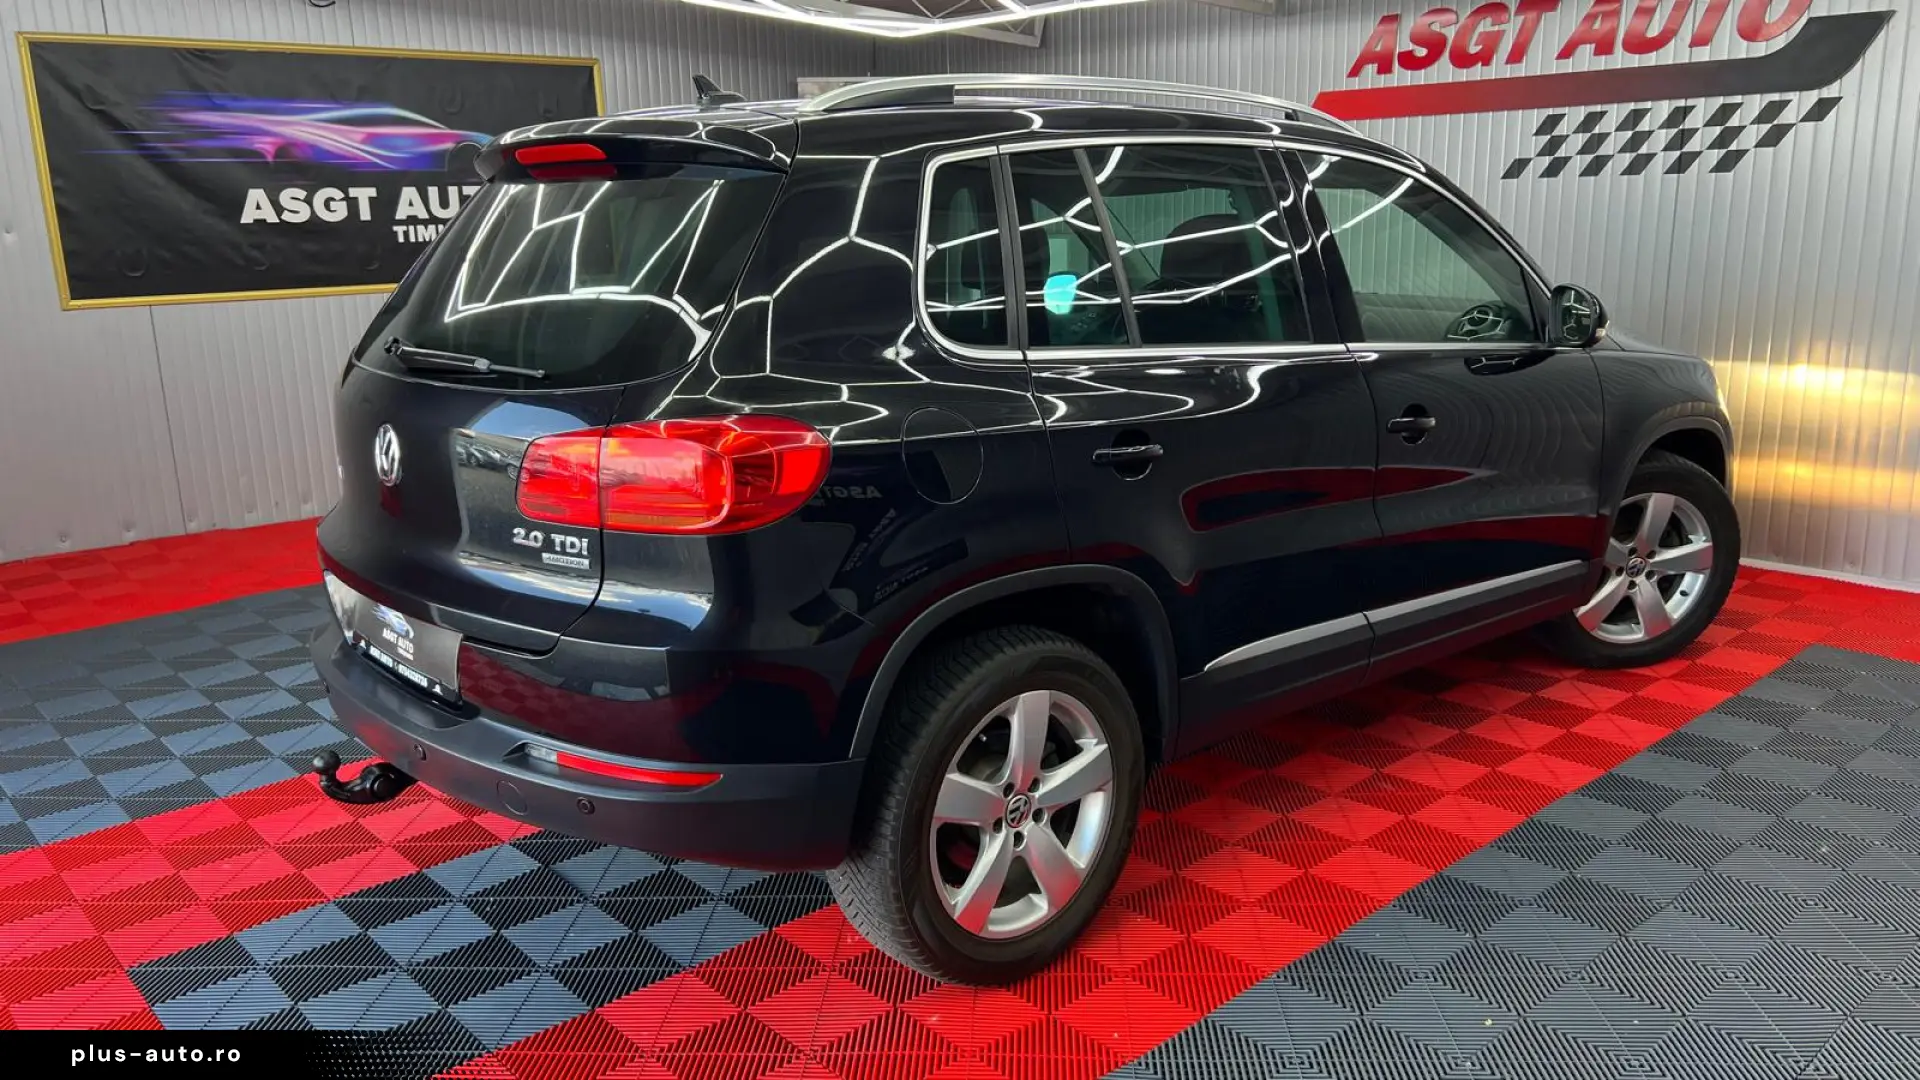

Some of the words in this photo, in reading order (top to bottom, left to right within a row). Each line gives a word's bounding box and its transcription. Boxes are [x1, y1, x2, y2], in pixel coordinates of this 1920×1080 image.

[1346, 0, 1560, 78] ASGT
[240, 186, 379, 224] ASGT
[394, 185, 481, 220] AU
[512, 527, 544, 548] 2.0
[550, 533, 589, 556] TDI
